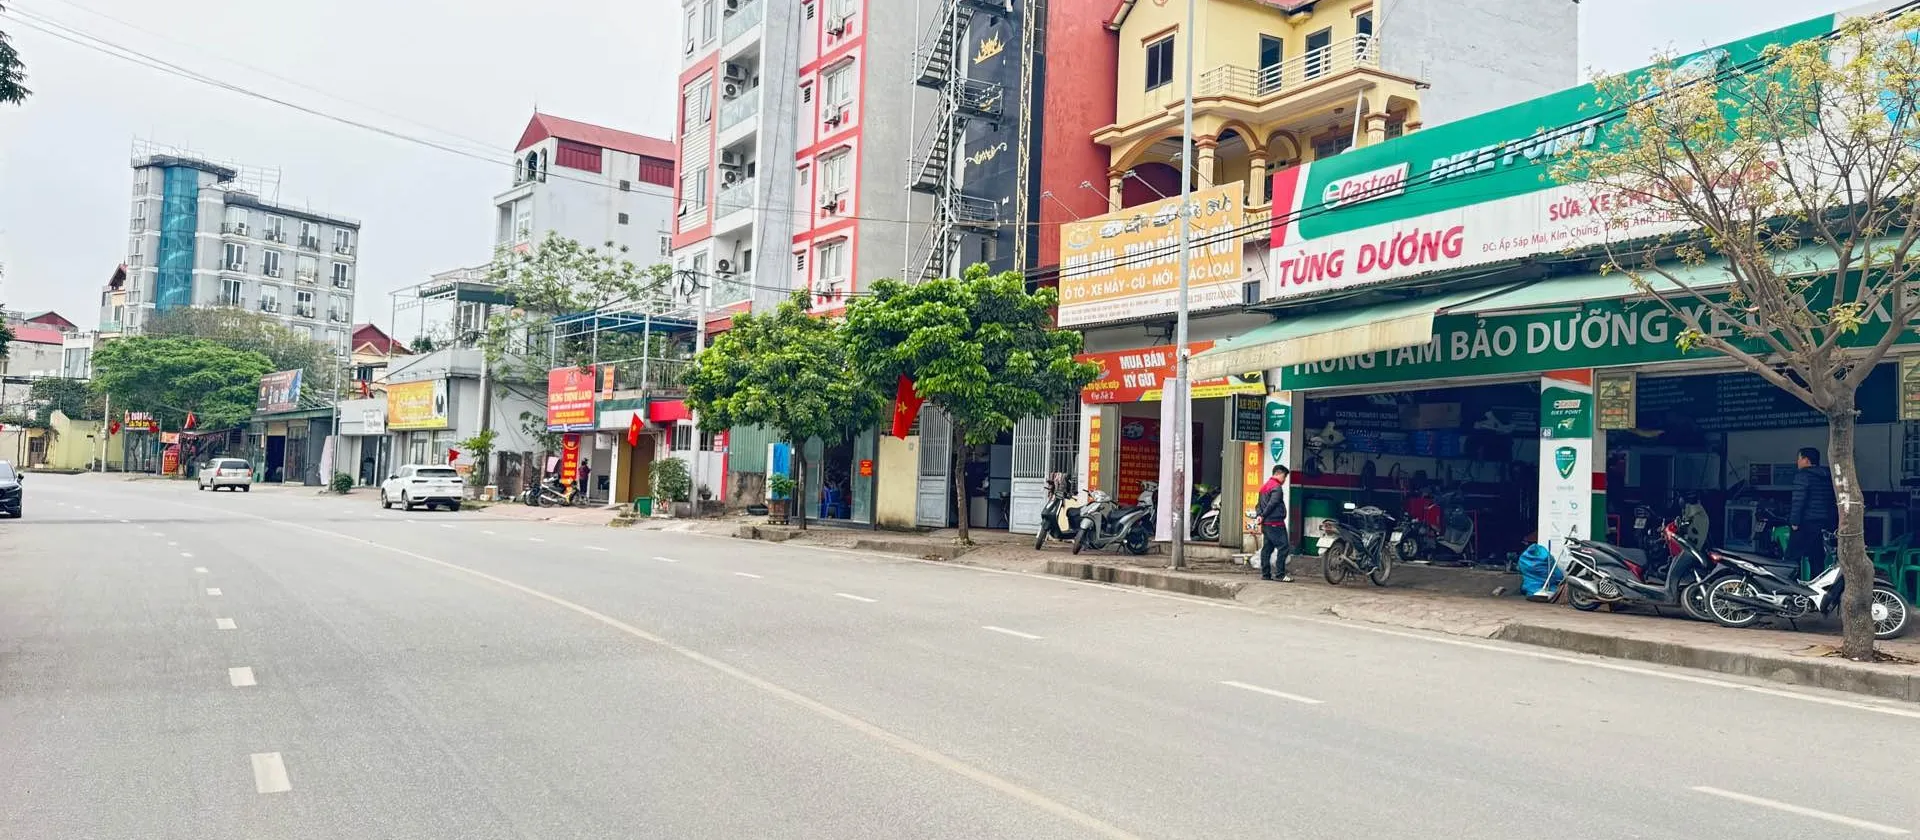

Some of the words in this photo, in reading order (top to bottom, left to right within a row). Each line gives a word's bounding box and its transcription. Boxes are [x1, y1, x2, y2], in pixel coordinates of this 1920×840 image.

[1429, 144, 1499, 184] BIKE
[1502, 116, 1604, 166] POINT
[1339, 168, 1402, 204] Castrol
[1588, 193, 1610, 216] XE
[1124, 239, 1154, 271] TRAO
[1280, 249, 1345, 288] TÙNG
[1357, 226, 1465, 274] DƯƠNG
[1091, 283, 1103, 297] XE
[1104, 277, 1126, 294] MÁY
[1131, 272, 1146, 290] CŨ
[1152, 268, 1174, 287] MỚI
[1187, 263, 1206, 281] ÁC
[1207, 259, 1234, 279] LOẠI
[1450, 317, 1518, 361] BẢO
[1526, 307, 1668, 354] DƯỠNG
[1681, 303, 1734, 338] XE
[1119, 354, 1143, 370] MUA
[1143, 350, 1166, 368] BÁN
[1123, 371, 1137, 388] KÝ
[1138, 369, 1156, 388] GỬI
